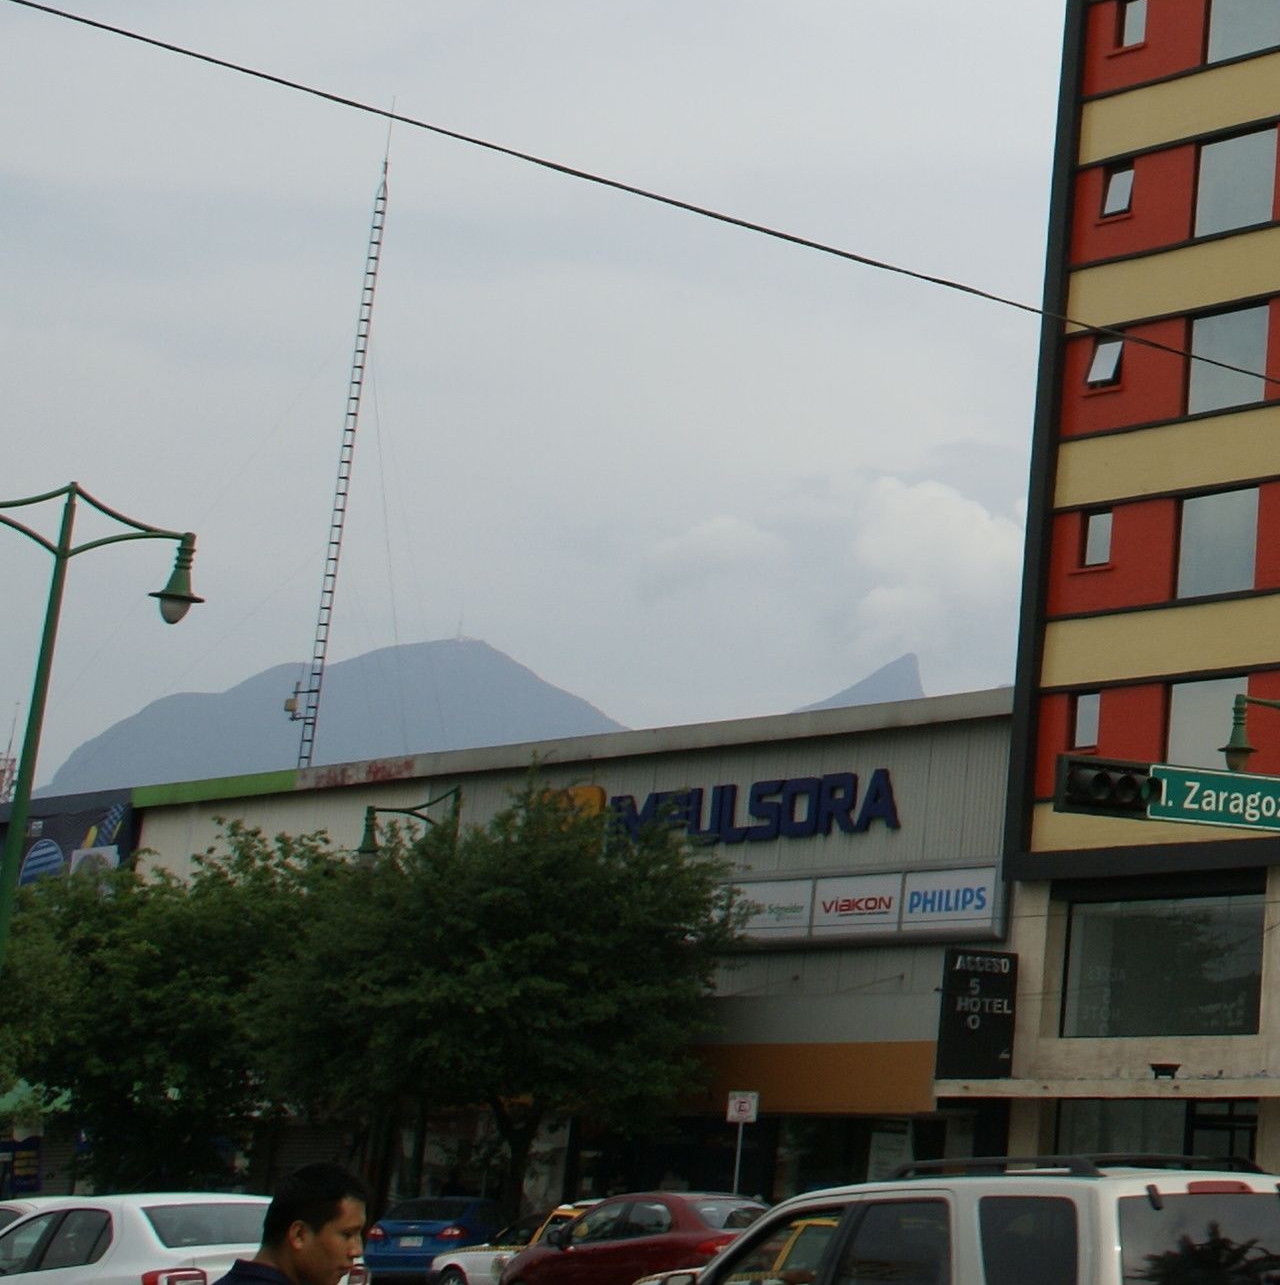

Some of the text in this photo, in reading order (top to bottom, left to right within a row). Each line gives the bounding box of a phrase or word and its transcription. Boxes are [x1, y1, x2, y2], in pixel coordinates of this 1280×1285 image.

[909, 886, 987, 913] PHILIPS
[955, 955, 1010, 973] ACCESO
[956, 996, 1012, 1014] HOTEL
